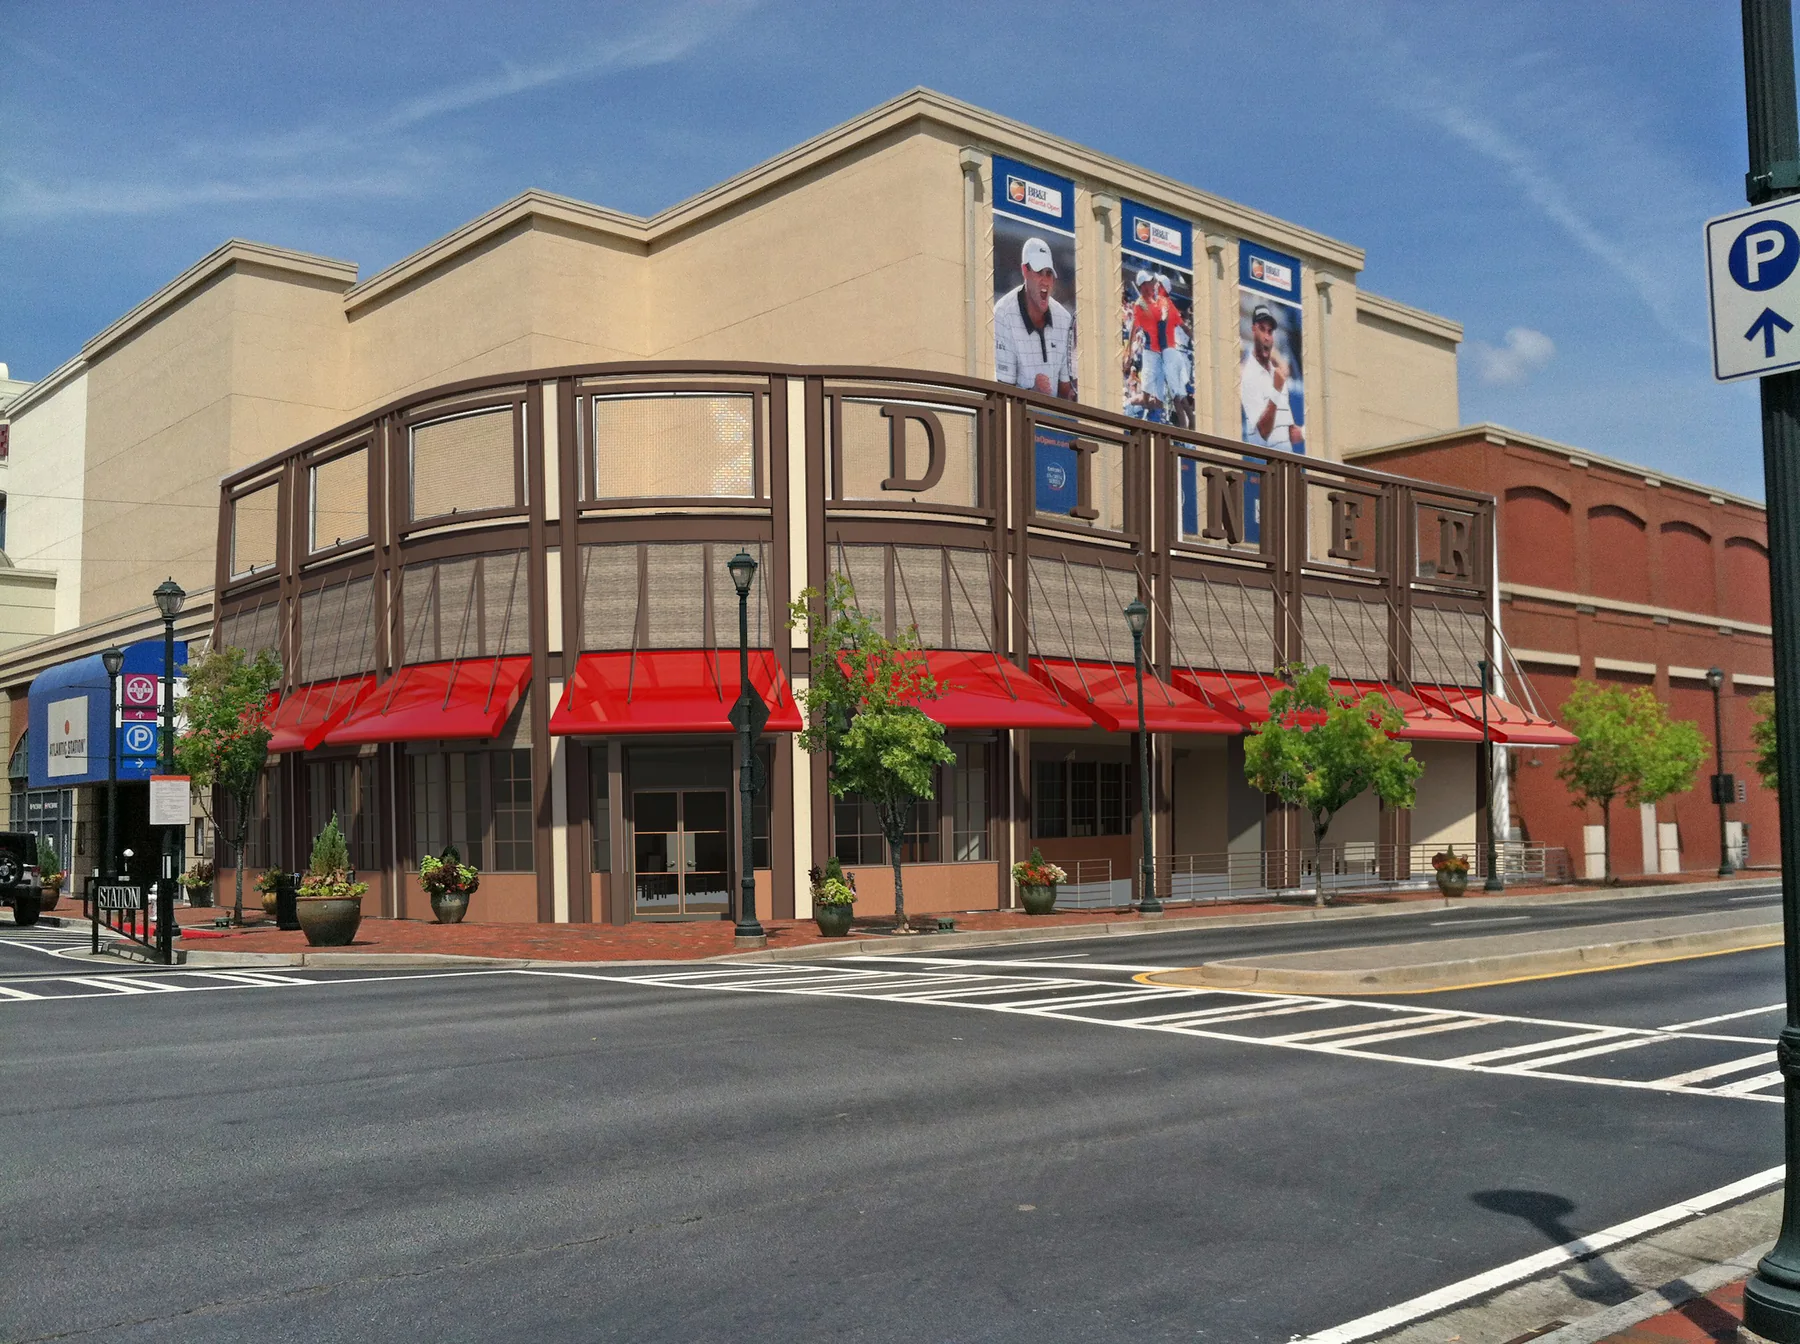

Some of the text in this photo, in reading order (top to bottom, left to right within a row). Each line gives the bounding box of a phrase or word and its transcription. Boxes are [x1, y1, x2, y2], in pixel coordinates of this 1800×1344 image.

[1028, 186, 1047, 201] BB&T
[1028, 197, 1061, 212] Atlanta Open
[1745, 229, 1786, 284] P
[880, 404, 1474, 578] DINER
[134, 729, 149, 747] P
[99, 886, 140, 909] STATION
